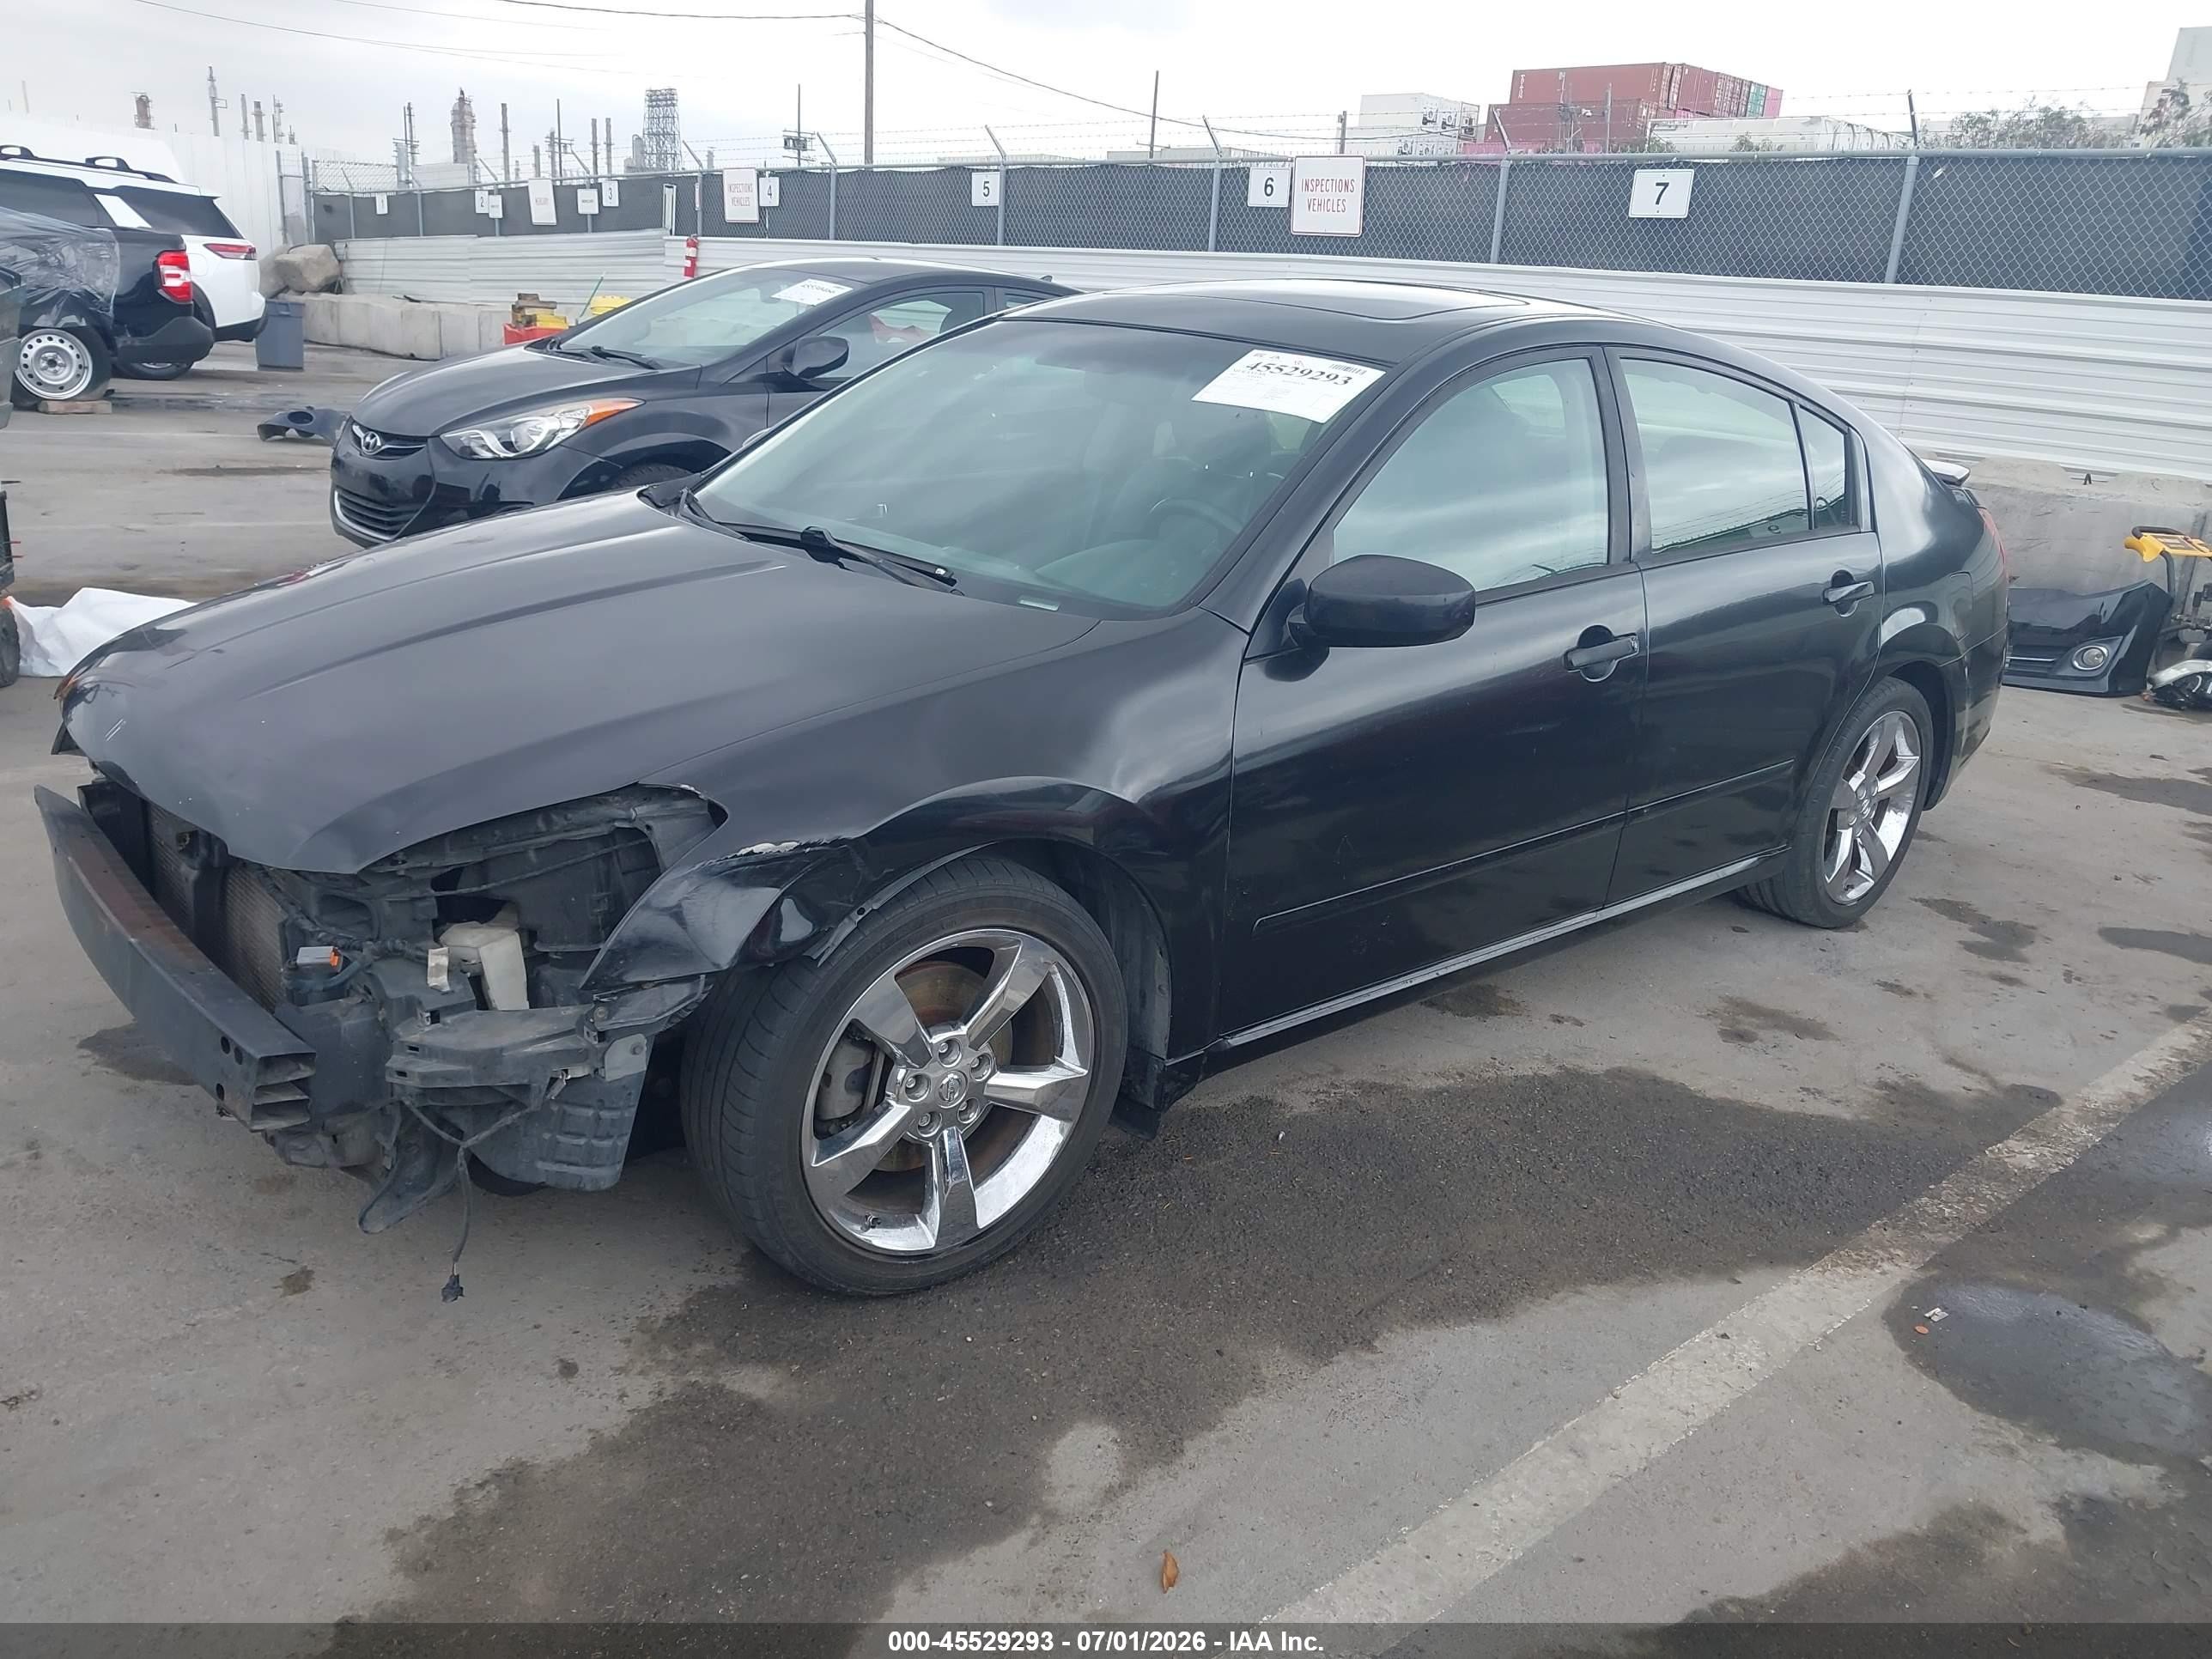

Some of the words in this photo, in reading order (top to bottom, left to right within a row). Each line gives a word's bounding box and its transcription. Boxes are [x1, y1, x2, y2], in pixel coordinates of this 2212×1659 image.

[728, 183, 753, 193] INSPECTIONS
[767, 185, 773, 199] 4
[982, 180, 990, 198] 5
[1263, 177, 1274, 198] 6
[1301, 178, 1355, 193] INSPECTIONS
[1655, 181, 1670, 205] 7
[608, 187, 613, 200] 3
[480, 196, 484, 207] 2
[731, 197, 750, 207] VEHICLES
[1307, 198, 1346, 213] VEHICLES
[1246, 361, 1353, 386] 45529293
